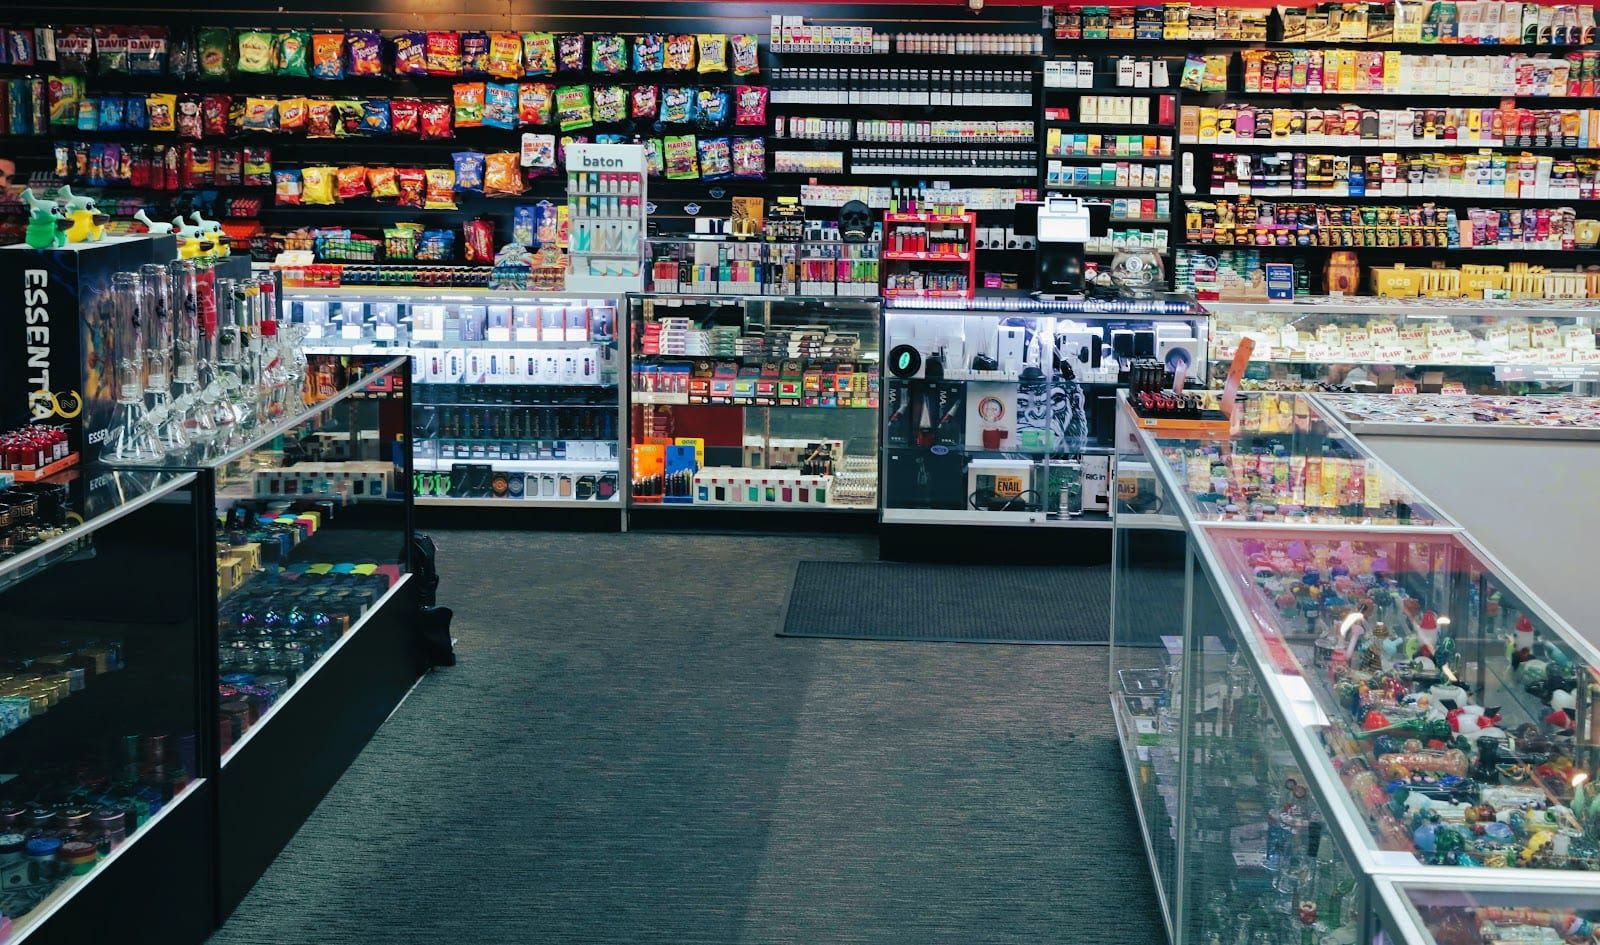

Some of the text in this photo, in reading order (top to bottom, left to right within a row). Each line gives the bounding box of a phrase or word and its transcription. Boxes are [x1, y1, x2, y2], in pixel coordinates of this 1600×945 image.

[667, 141, 692, 149] HARIBO
[584, 156, 622, 168] baton
[1388, 278, 1410, 287] OCB
[1469, 280, 1492, 288] OCB
[1374, 326, 1394, 334] RAW
[1432, 328, 1454, 336] RAW
[1536, 327, 1556, 336] RAW
[1411, 352, 1430, 360] RAW
[998, 480, 1021, 492] ENAIL
